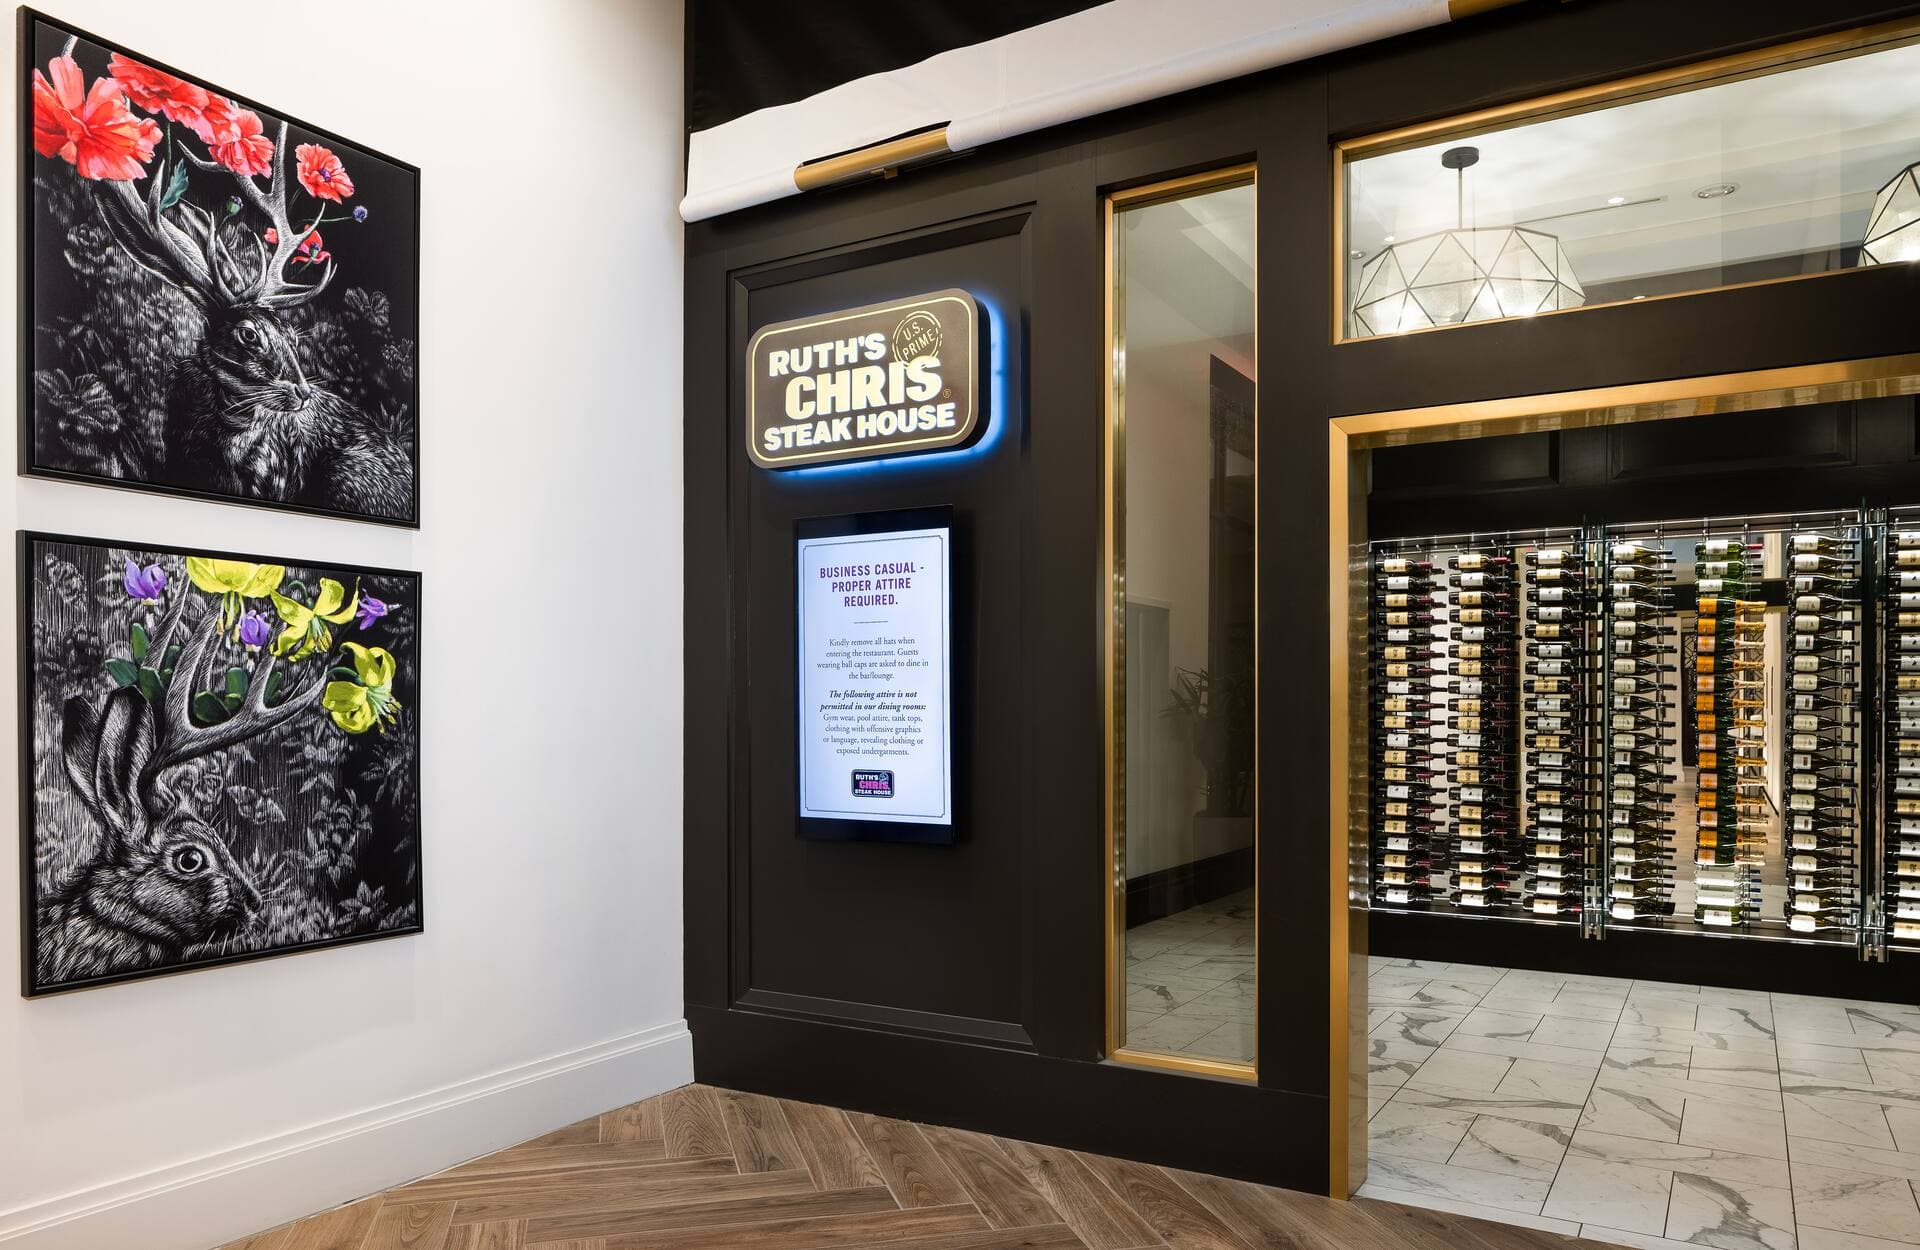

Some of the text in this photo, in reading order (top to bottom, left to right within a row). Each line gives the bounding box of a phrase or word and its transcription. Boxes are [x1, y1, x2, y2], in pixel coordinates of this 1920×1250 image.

[903, 321, 924, 341] U.S.
[902, 328, 936, 361] PRIME
[768, 332, 887, 377] RUTH'S
[785, 355, 943, 420] CHRIS
[763, 402, 956, 451] STEAK HOUSE
[820, 565, 870, 578] BUSINESS
[875, 562, 916, 575] CASUAL
[832, 578, 911, 592] PROPER ATTIRE
[845, 594, 898, 607] REQUIRED.
[829, 638, 850, 647] Kindly
[817, 661, 840, 670] wearing
[854, 661, 867, 669] caps
[906, 659, 919, 667] dine
[860, 672, 894, 681] bar/lounge.
[829, 690, 841, 698] The
[842, 690, 875, 700] following
[820, 702, 853, 712] permitted
[855, 702, 862, 710] in
[878, 702, 901, 712] dining
[823, 714, 838, 723] Gym
[857, 714, 870, 723] pool
[908, 715, 922, 723] tops,
[825, 724, 850, 734] clothing
[895, 725, 921, 734] graphics
[831, 736, 859, 745] language,
[861, 736, 887, 746] revealing
[889, 737, 915, 746] clothing
[836, 747, 909, 757] exposed undergarments.
